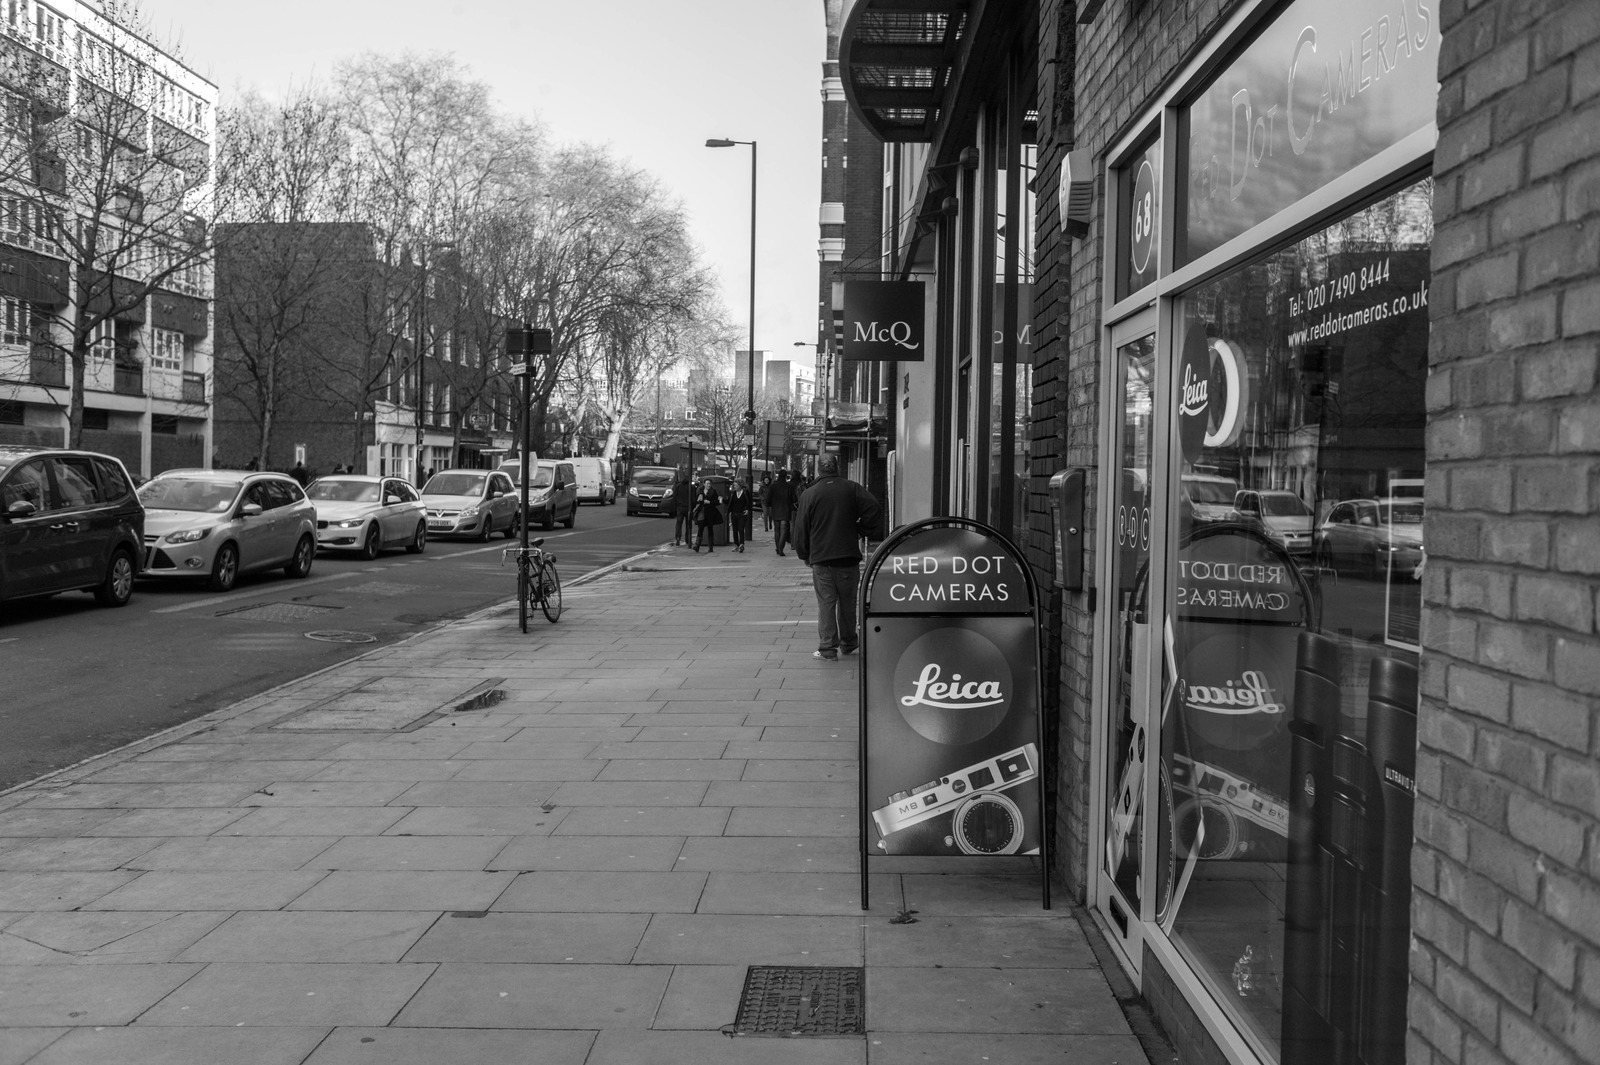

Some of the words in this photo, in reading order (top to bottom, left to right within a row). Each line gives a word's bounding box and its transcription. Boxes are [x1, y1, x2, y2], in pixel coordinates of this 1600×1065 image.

[1136, 191, 1152, 244] 68
[1288, 297, 1304, 318] Tel:
[1307, 284, 1326, 311] 020
[1329, 271, 1357, 302] 7490
[1360, 257, 1390, 291] 8444
[853, 321, 919, 350] McQ
[1287, 279, 1428, 348] www.reddotcameras.co.uk
[1179, 363, 1208, 416] Leica
[893, 556, 938, 574] RED
[952, 556, 1005, 574] DOT
[890, 583, 1009, 601] CAMERAS
[901, 663, 1004, 709] Leica
[899, 801, 918, 815] M8
